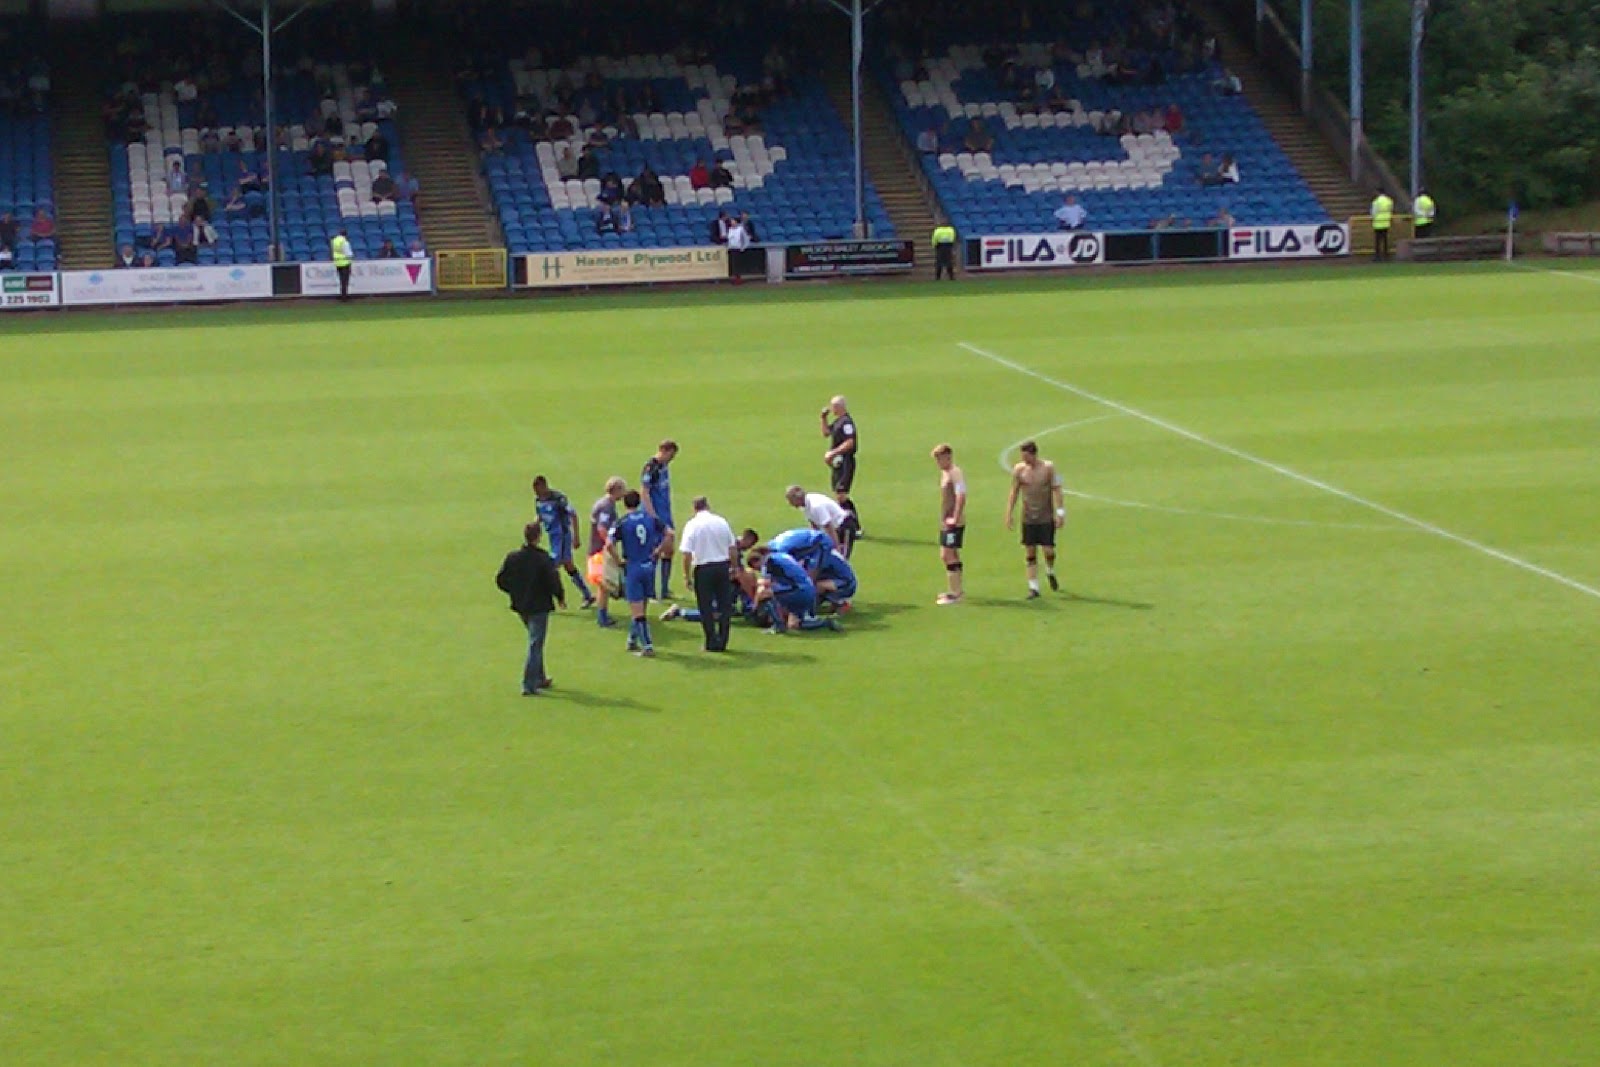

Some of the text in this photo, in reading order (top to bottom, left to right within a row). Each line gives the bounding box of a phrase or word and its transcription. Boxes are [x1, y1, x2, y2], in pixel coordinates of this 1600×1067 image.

[985, 238, 1055, 263] FILA
[1071, 237, 1098, 260] JD
[1233, 229, 1302, 254] FILA
[1316, 227, 1343, 251] JD
[634, 252, 692, 268] Plywood
[697, 250, 721, 262] Ltd
[636, 523, 647, 545] 9
